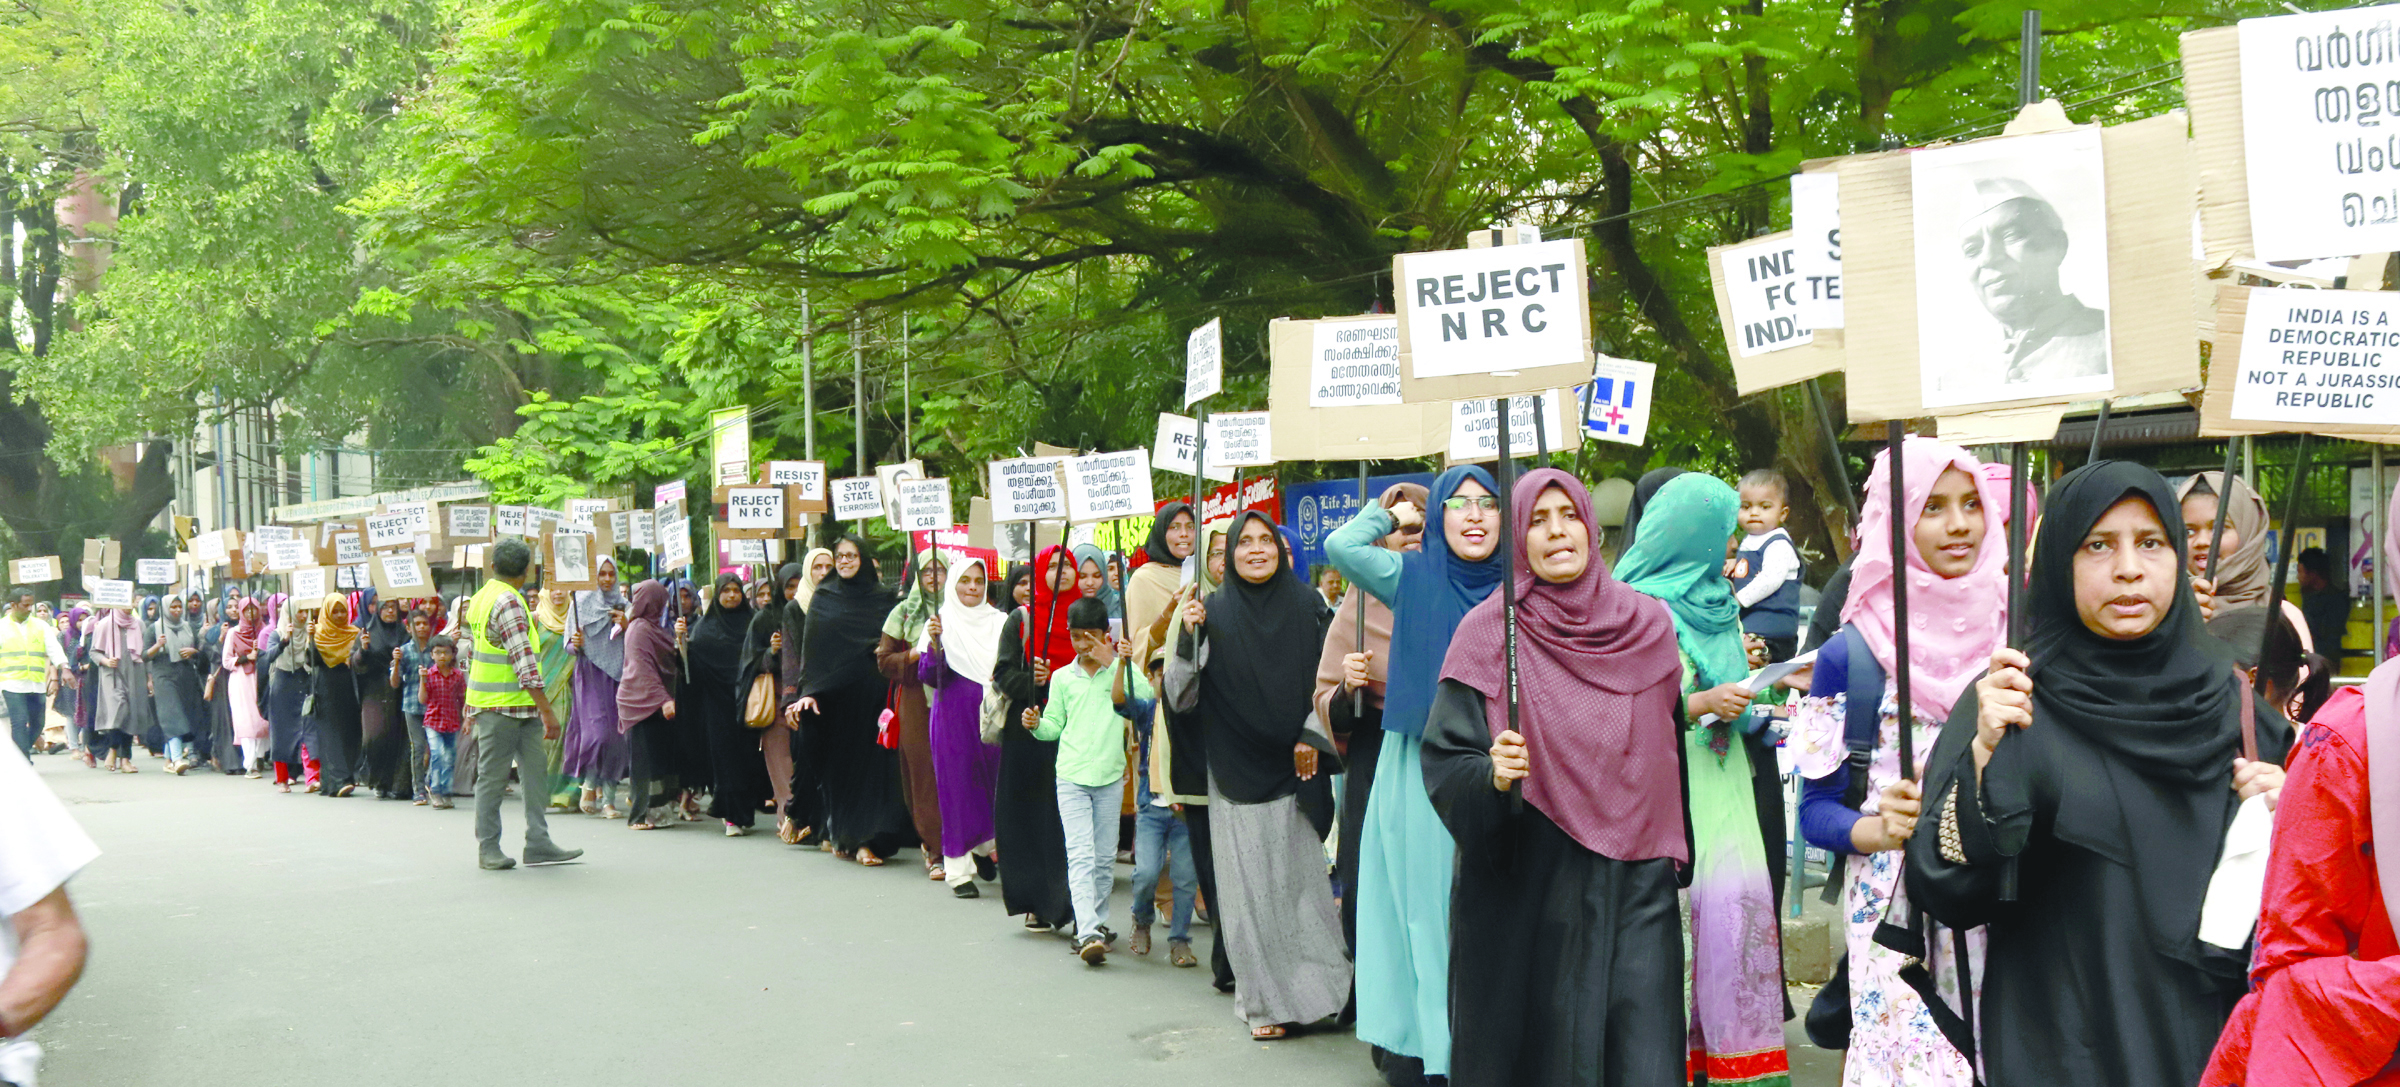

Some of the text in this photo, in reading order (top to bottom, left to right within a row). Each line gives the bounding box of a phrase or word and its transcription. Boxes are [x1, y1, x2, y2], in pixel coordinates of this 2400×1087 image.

[1416, 263, 1566, 307] REJECT
[2288, 308, 2389, 326] INDIA IS A
[1744, 314, 1812, 349] INDI
[2269, 328, 2400, 347] DEMOCRATIC
[2282, 350, 2383, 368] REPUBLIC
[2248, 370, 2288, 386] NOT
[2295, 372, 2308, 386] A
[2276, 391, 2374, 409] REPUBLIC
[775, 471, 819, 480] RESIST
[845, 481, 870, 492] STOP
[732, 495, 780, 506] REJECT
[843, 491, 874, 503] STATE
[838, 502, 880, 513] TERRORISM
[1319, 495, 1341, 514] Life
[369, 517, 408, 530] REJECT
[916, 516, 936, 527] CAB
[344, 544, 352, 552] IS
